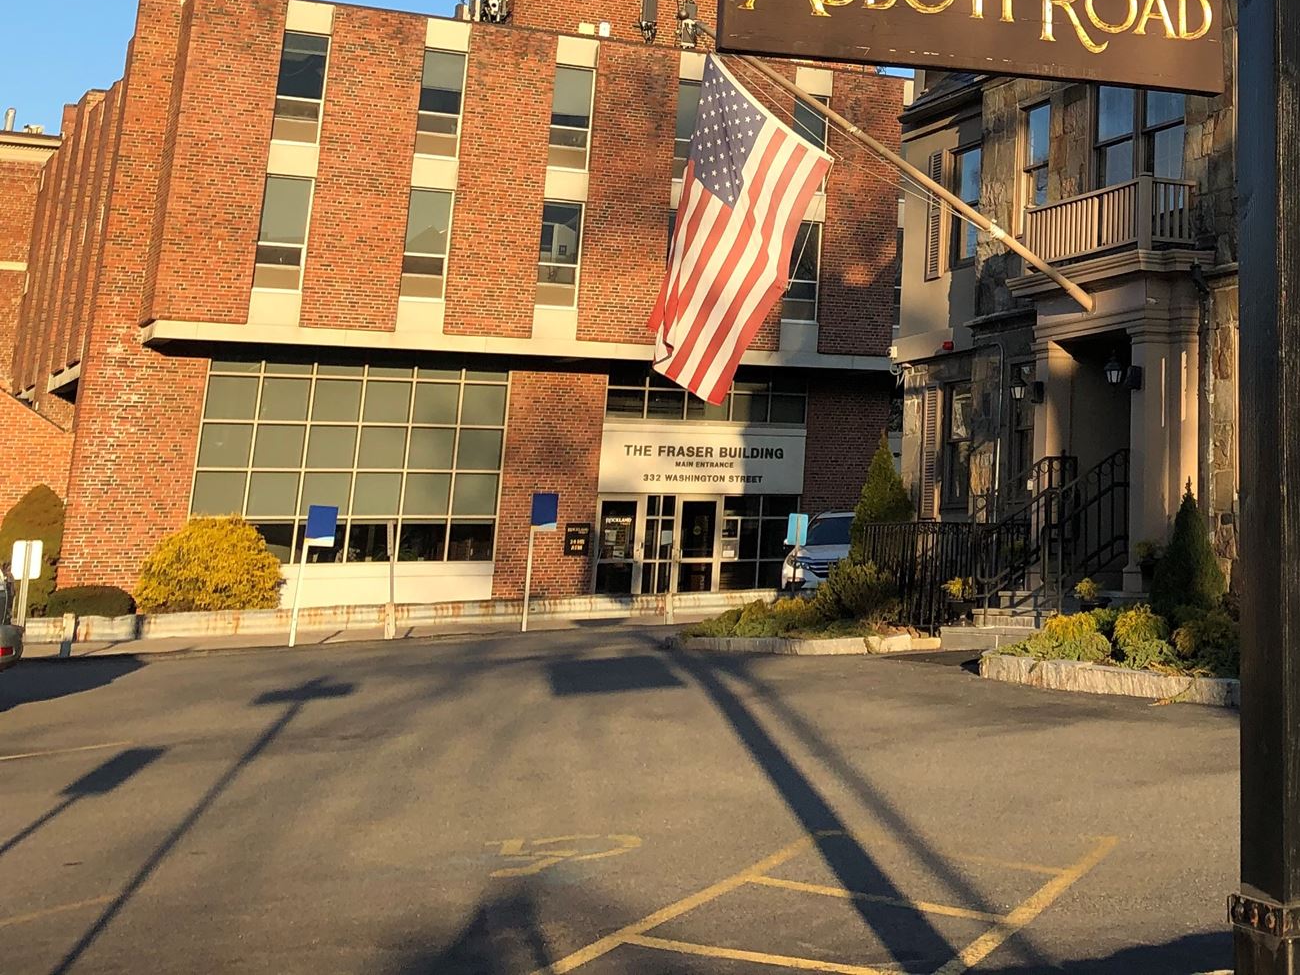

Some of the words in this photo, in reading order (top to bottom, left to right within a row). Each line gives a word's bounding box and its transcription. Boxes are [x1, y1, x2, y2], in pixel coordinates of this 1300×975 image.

[624, 444, 652, 457] THE
[658, 445, 714, 458] FRASER
[719, 446, 784, 460] BUILDING
[696, 461, 734, 469] ENTRANCE
[643, 473, 661, 482] 332
[665, 474, 726, 483] WASHINGTON
[729, 475, 763, 484] STREET
